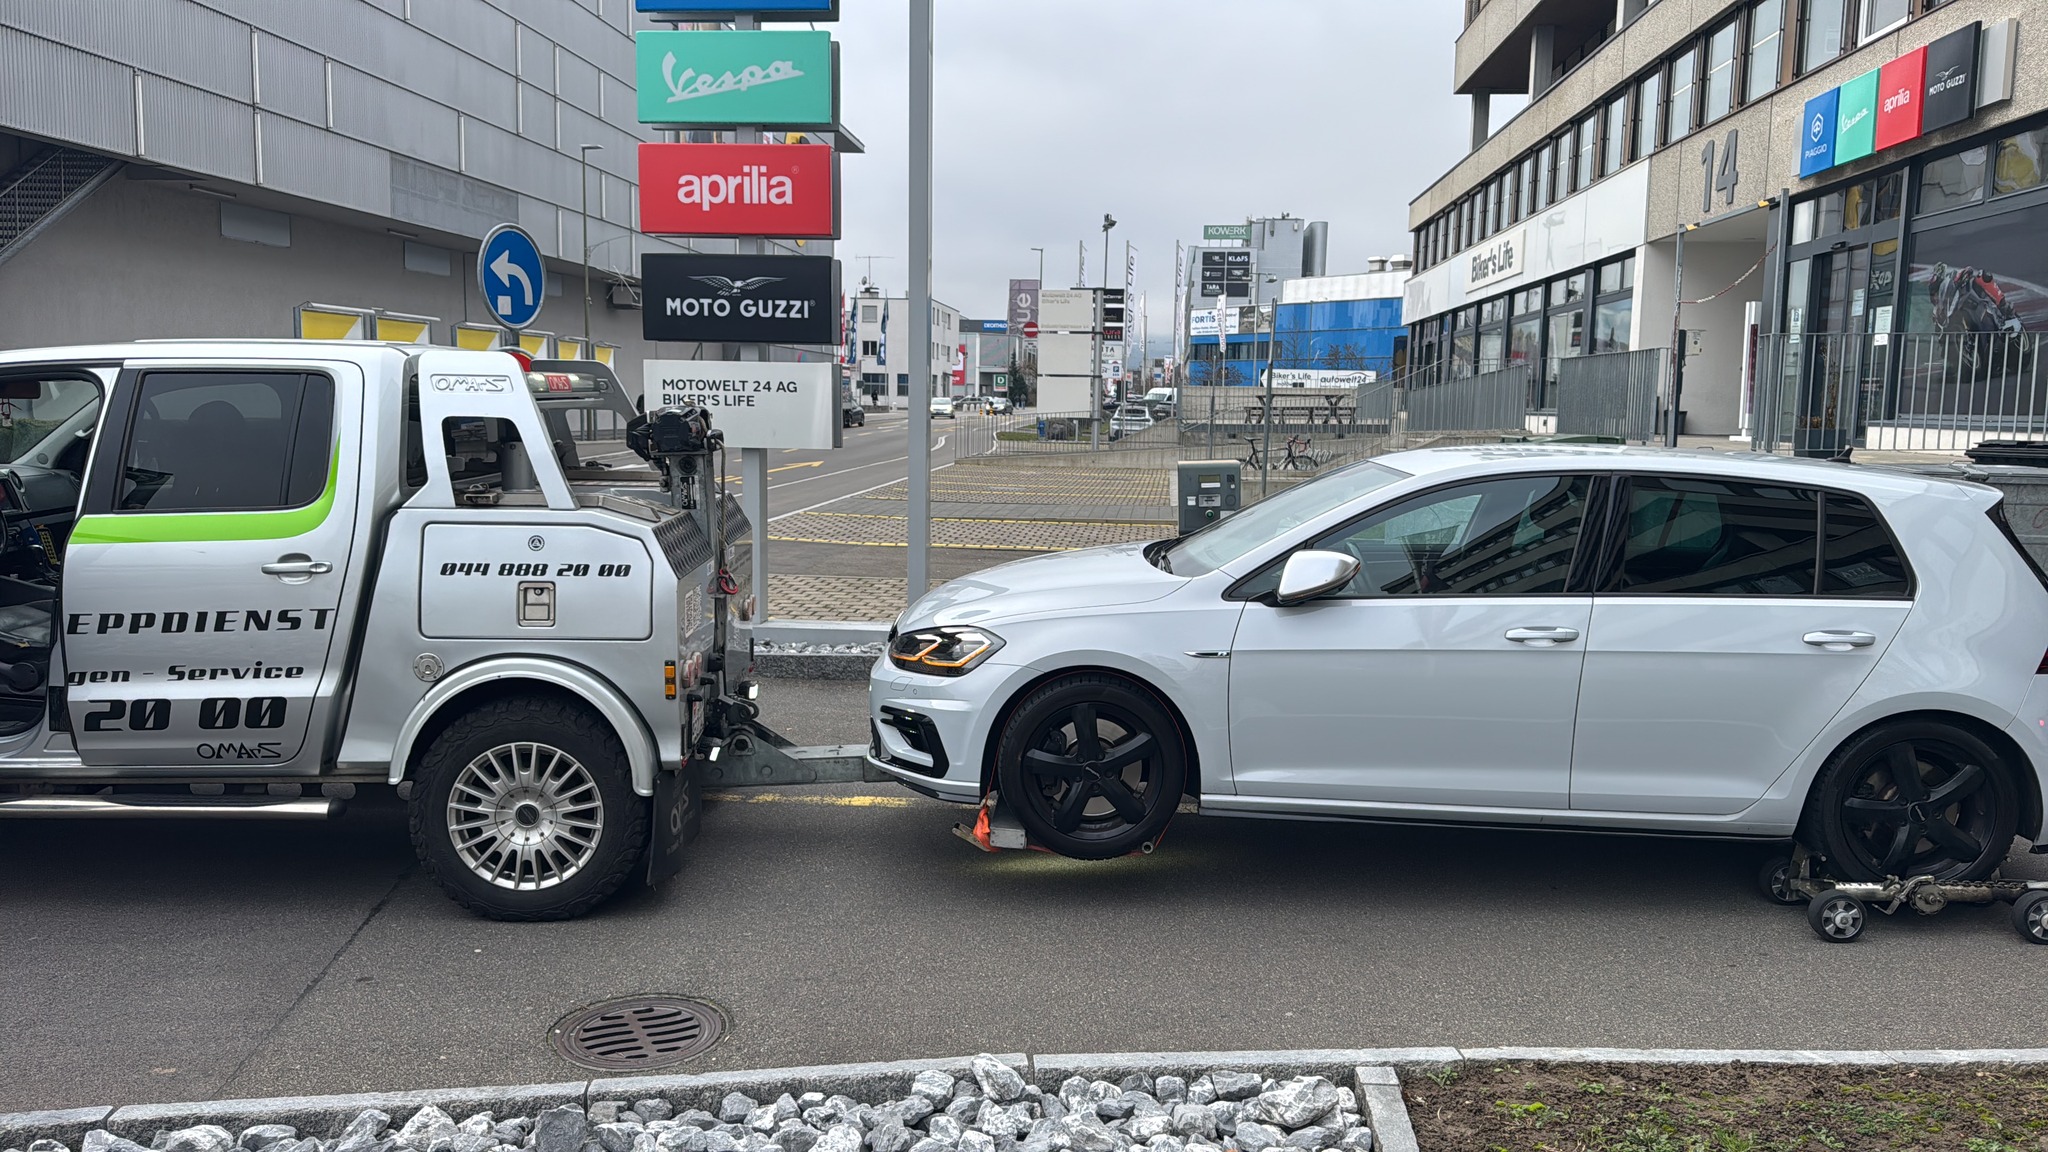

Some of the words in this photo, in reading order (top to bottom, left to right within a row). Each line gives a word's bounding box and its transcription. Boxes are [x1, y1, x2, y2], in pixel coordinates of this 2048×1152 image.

[662, 51, 804, 103] Vespa
[1928, 81, 1945, 97] MOTO
[1946, 73, 1967, 89] GUZZI
[1883, 87, 1910, 114] aprilia
[1841, 108, 1869, 135] Vespa
[1805, 142, 1828, 160] PIAGGIO
[1701, 128, 1739, 213] 14
[677, 165, 793, 212] aprilia
[1471, 247, 1497, 283] Biker's
[1497, 240, 1514, 273] Life
[665, 298, 731, 317] MOTO
[740, 299, 809, 319] GUZZI
[662, 379, 749, 392] MOTOWELT
[752, 381, 772, 393] 24
[776, 381, 798, 393] AG
[1298, 372, 1312, 380] Life
[1320, 375, 1367, 384] autowelt24
[662, 394, 720, 407] BIKER'S
[724, 395, 755, 407] LIFE
[440, 562, 490, 577] 044
[498, 563, 549, 577] 888
[556, 563, 590, 577] 20
[598, 564, 632, 577] 00
[167, 661, 304, 682] Service
[84, 699, 173, 732] 20
[199, 696, 288, 730] 00
